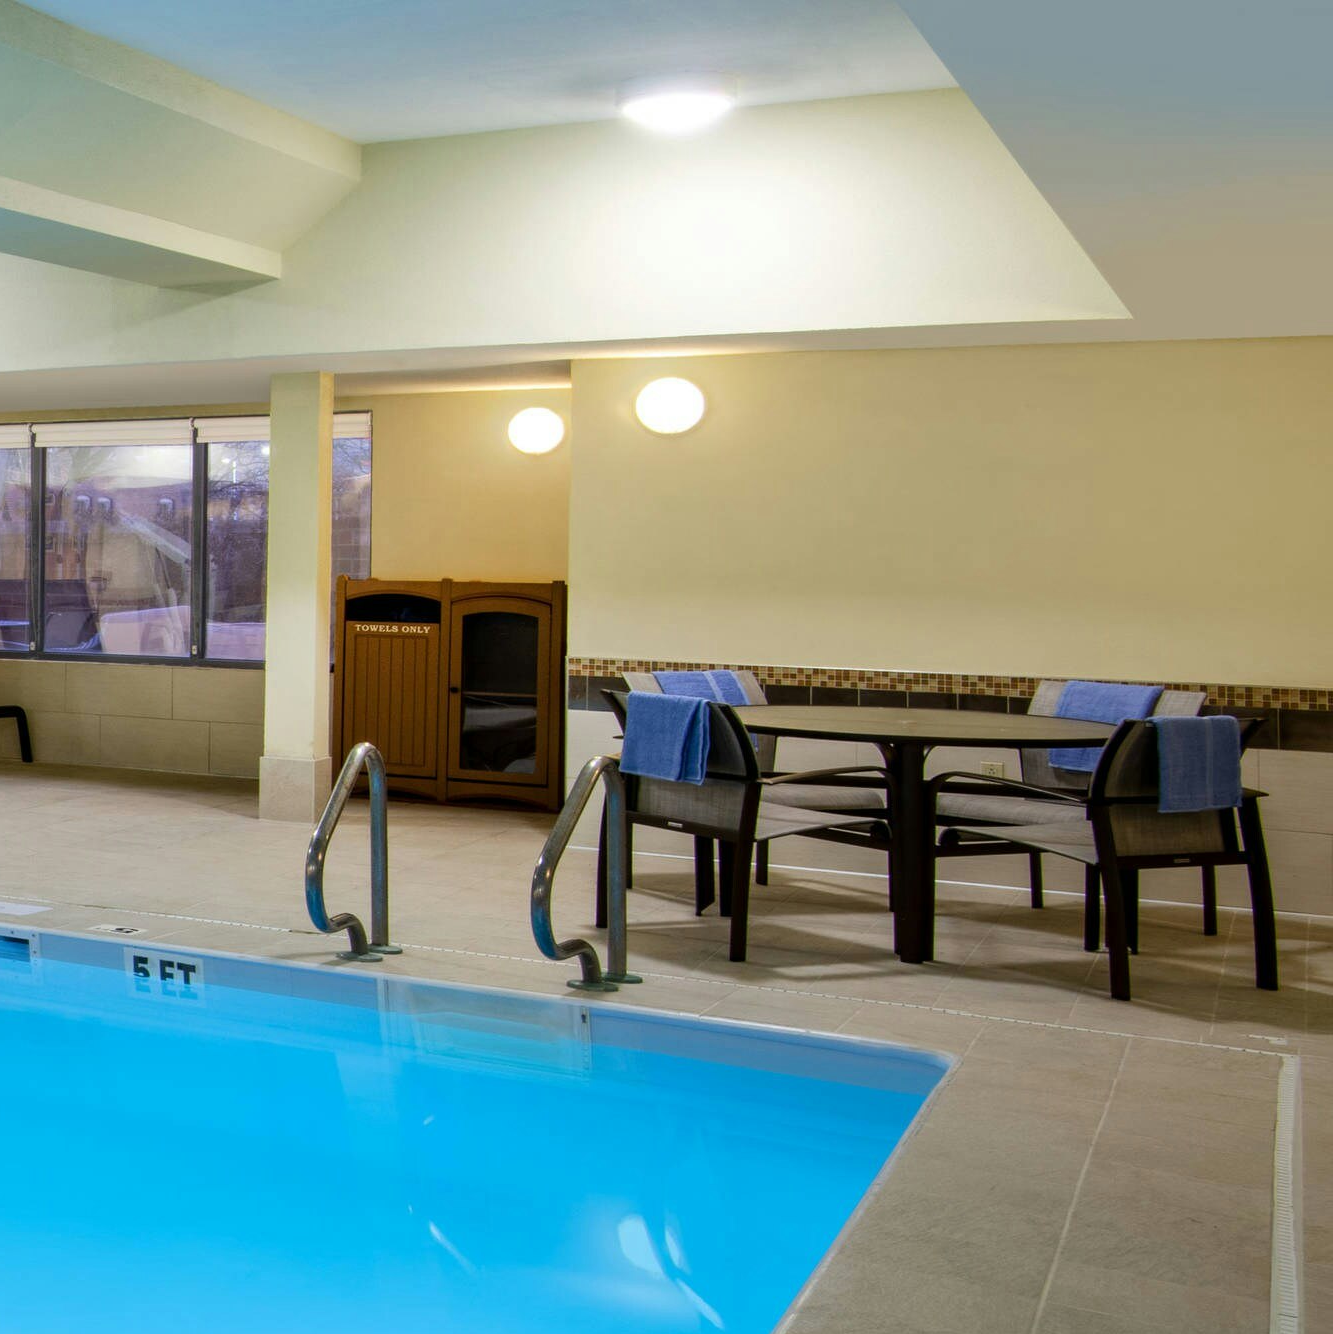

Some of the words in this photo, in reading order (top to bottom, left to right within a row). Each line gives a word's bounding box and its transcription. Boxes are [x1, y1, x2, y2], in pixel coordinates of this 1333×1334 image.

[354, 623, 399, 633] TOWELS
[401, 625, 431, 634] ONLY
[133, 955, 151, 978] 5
[159, 959, 196, 985] FT
